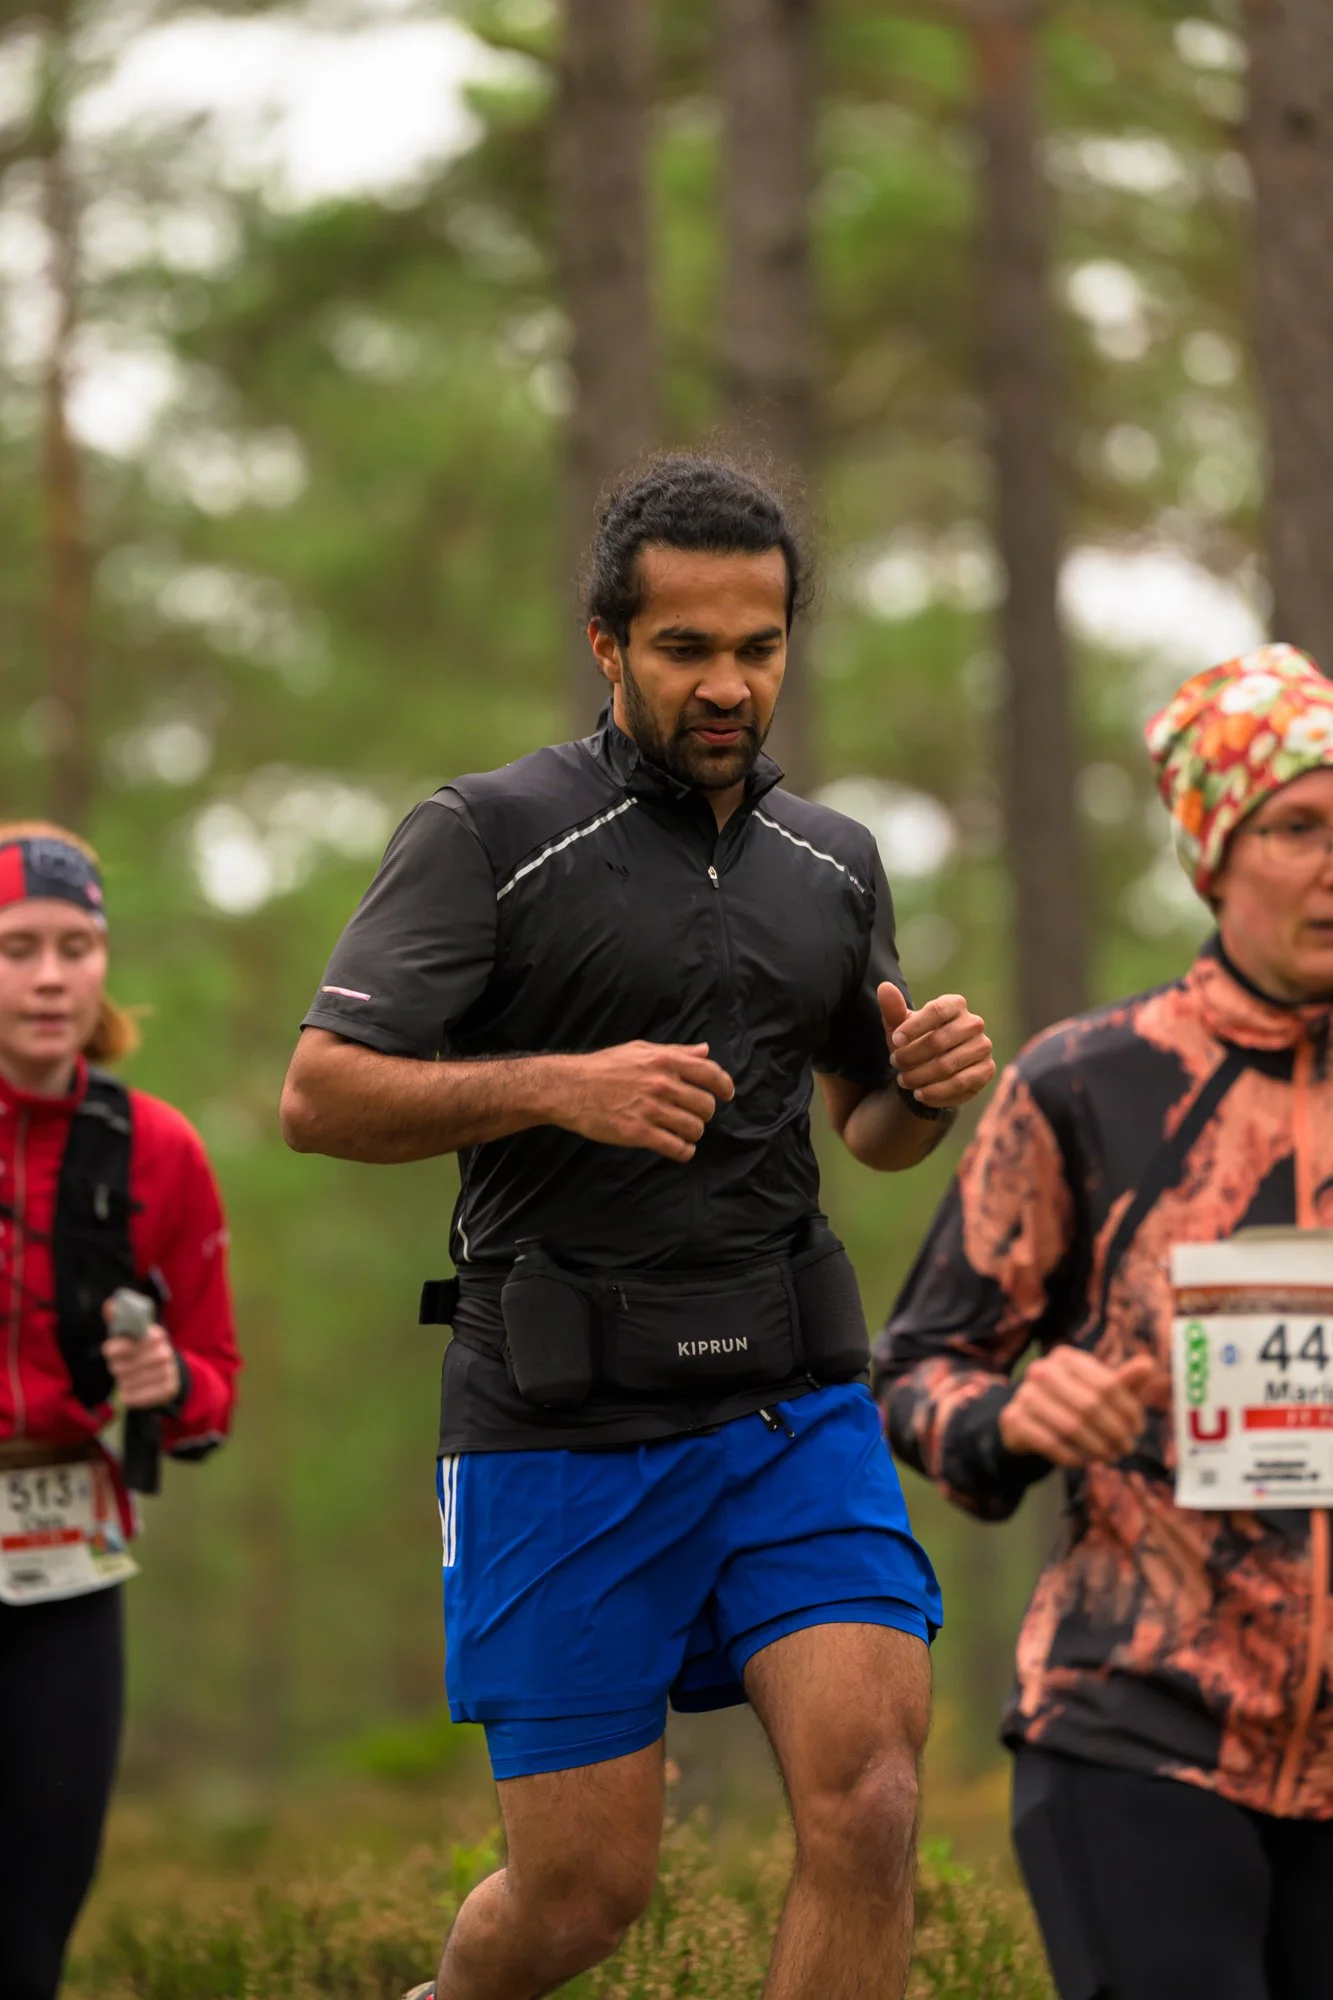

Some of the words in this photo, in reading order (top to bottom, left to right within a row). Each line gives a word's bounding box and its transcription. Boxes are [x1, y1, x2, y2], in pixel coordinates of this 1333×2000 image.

[678, 1337, 748, 1356] KIPRUN
[1257, 1322, 1333, 1371] 44
[9, 1469, 72, 1513] 513
